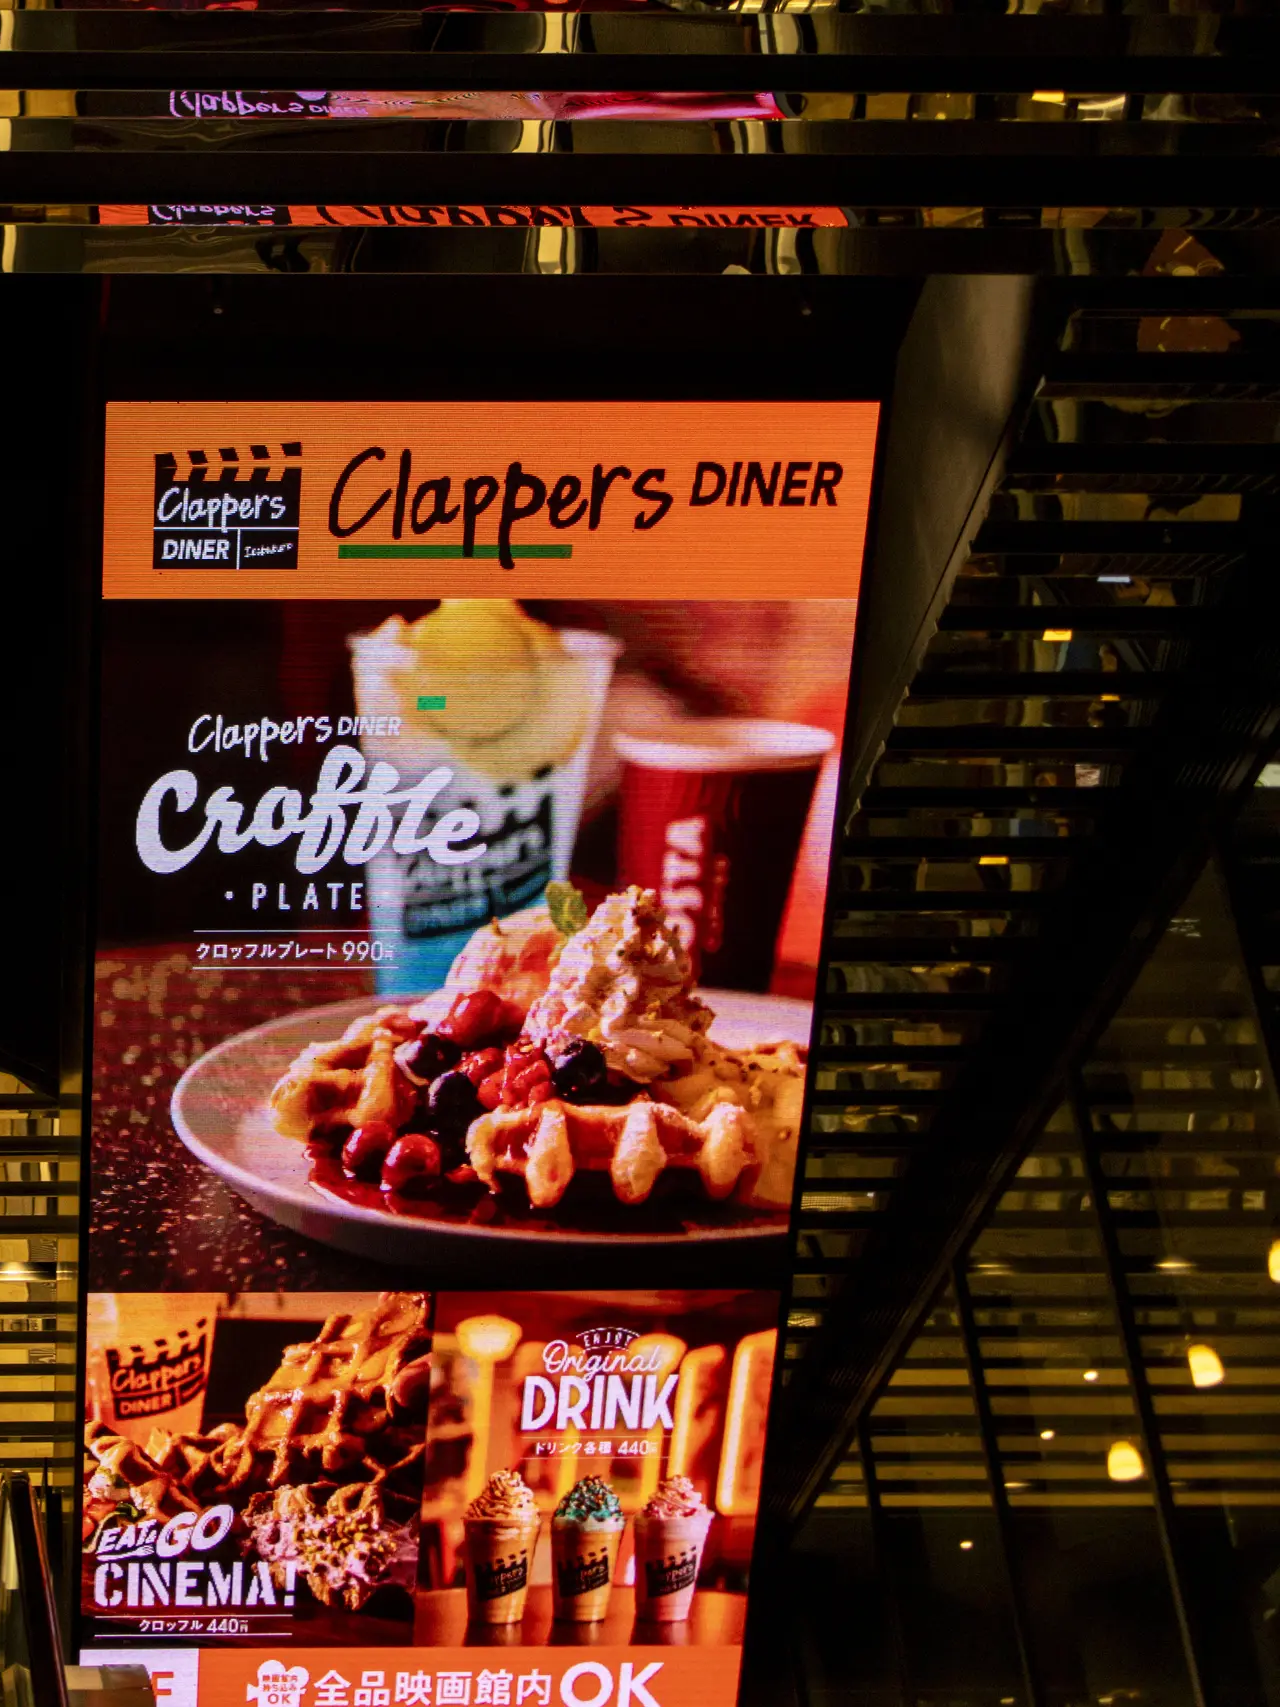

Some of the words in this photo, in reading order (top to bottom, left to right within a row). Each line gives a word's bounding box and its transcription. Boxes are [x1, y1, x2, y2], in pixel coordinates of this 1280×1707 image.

[157, 487, 286, 533] Clappers
[328, 446, 675, 570] Clappers
[689, 461, 844, 508] DINER
[161, 539, 230, 560] DINER
[188, 714, 332, 762] Clappers
[337, 716, 402, 737] DINER
[135, 744, 487, 875] Croffle
[251, 883, 364, 910] PLATE
[196, 943, 337, 960] クロッフルプレート
[543, 1340, 662, 1382] Original
[521, 1374, 679, 1431] DRINK
[94, 1560, 298, 1607] CINEMA!
[139, 1619, 204, 1633] クロッフル
[267, 1693, 292, 1705] OK
[314, 1669, 552, 1706] 全品映画館内
[559, 1660, 665, 1707] OK
